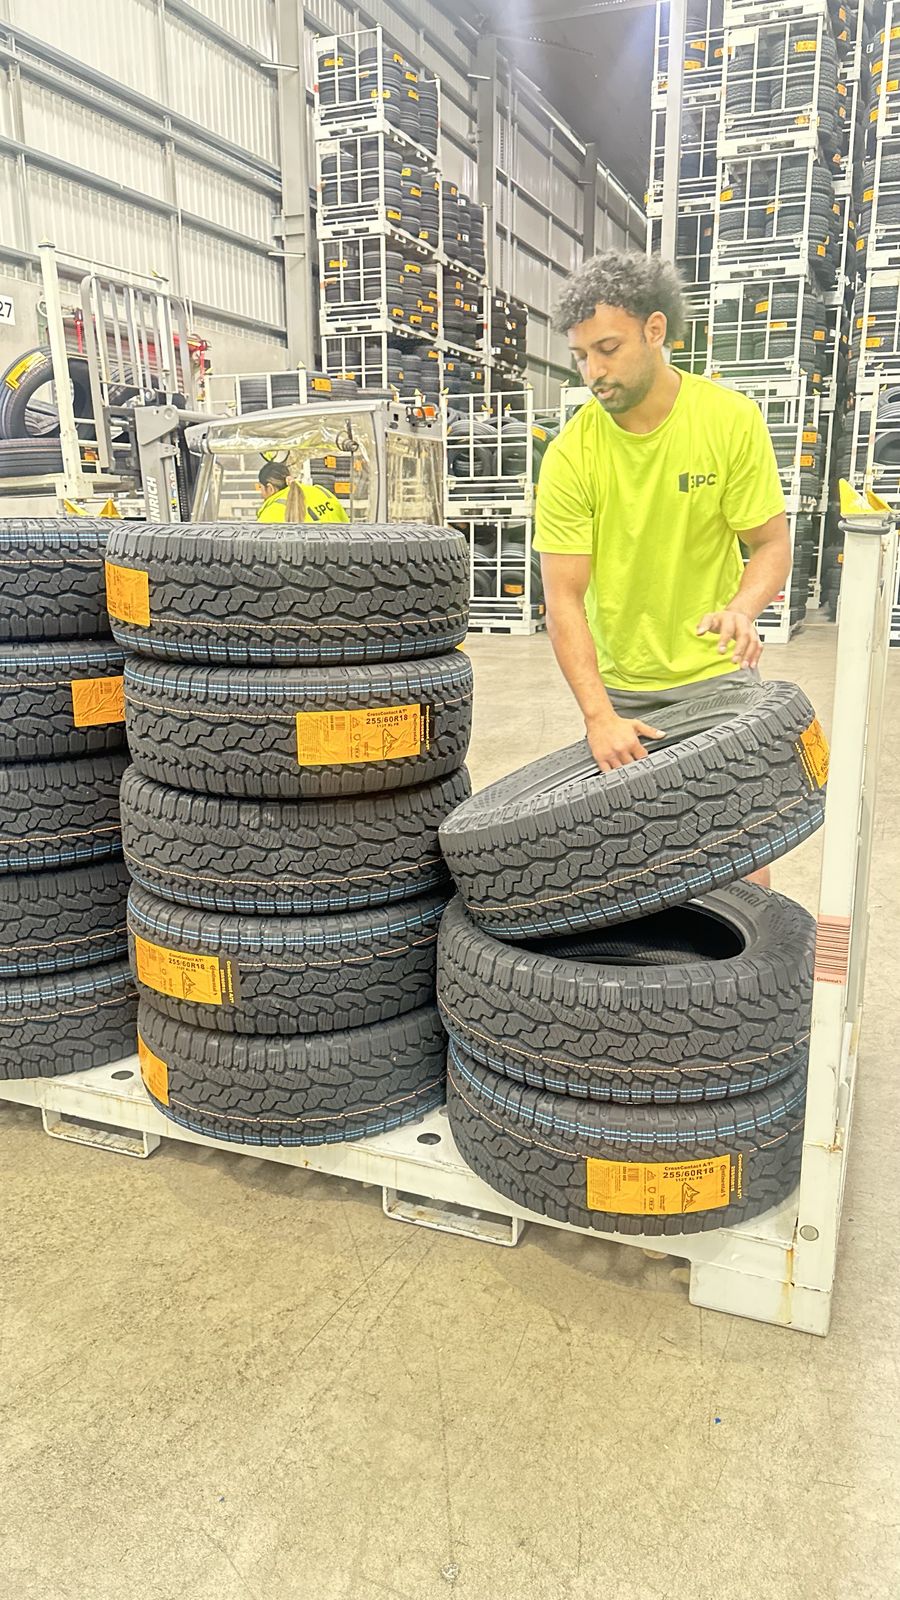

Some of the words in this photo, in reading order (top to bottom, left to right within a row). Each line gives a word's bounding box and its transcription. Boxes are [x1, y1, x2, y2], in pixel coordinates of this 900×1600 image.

[146, 476, 160, 522] INRICH
[366, 714, 409, 724] 255/60R18
[664, 1163, 702, 1171] CrossContact
[663, 1167, 714, 1178] 255/60R18
